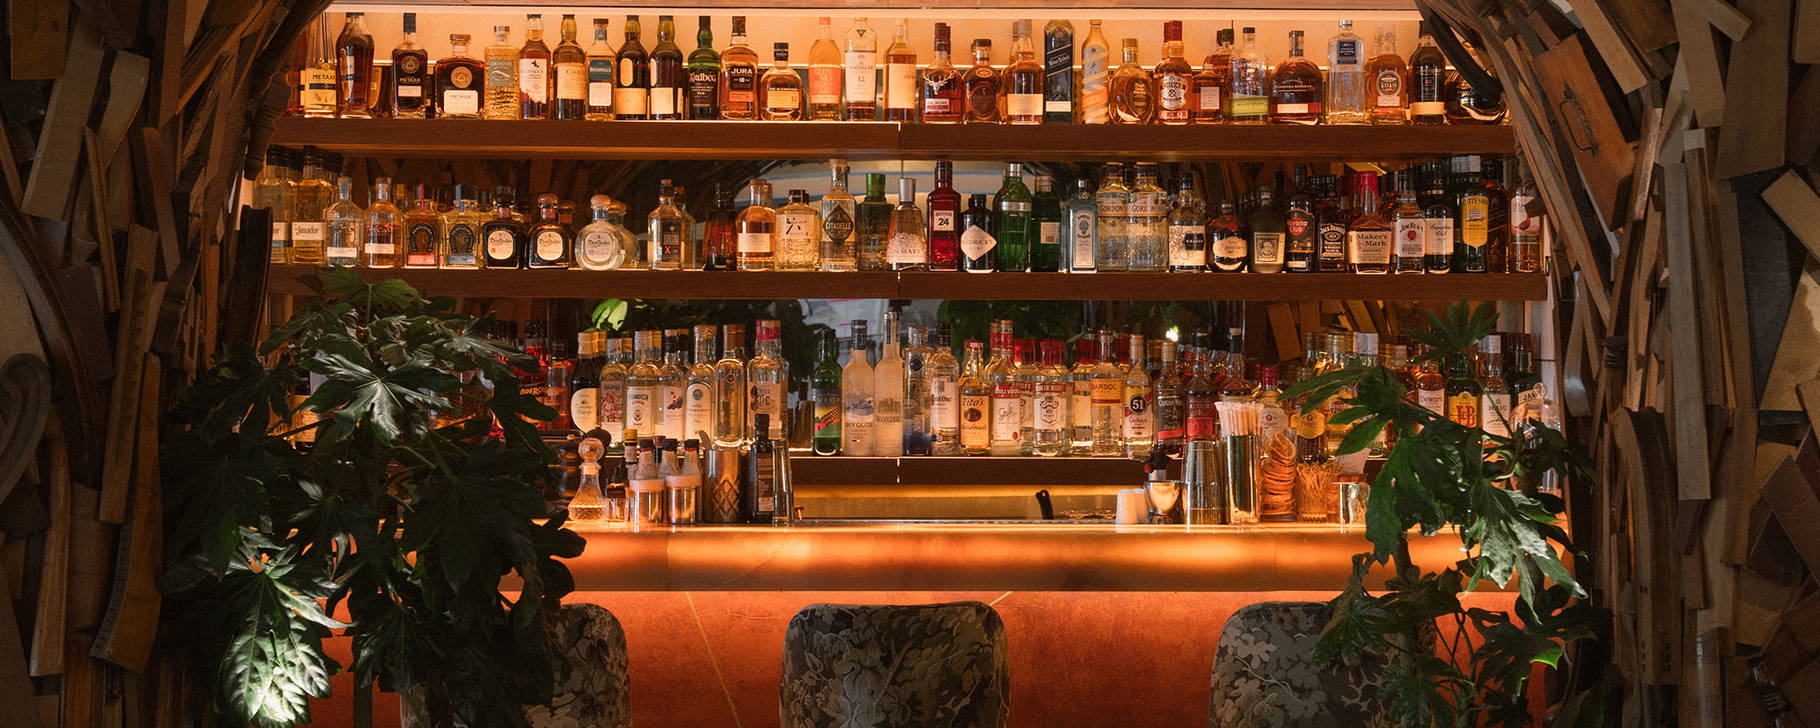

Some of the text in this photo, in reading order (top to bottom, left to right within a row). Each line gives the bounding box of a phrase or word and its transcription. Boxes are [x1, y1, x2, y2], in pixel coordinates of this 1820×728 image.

[825, 221, 852, 230] CITADELLE
[938, 218, 950, 226] 24
[1355, 232, 1388, 240] Maker's
[961, 397, 985, 406] Tito's
[1132, 399, 1144, 410] 51
